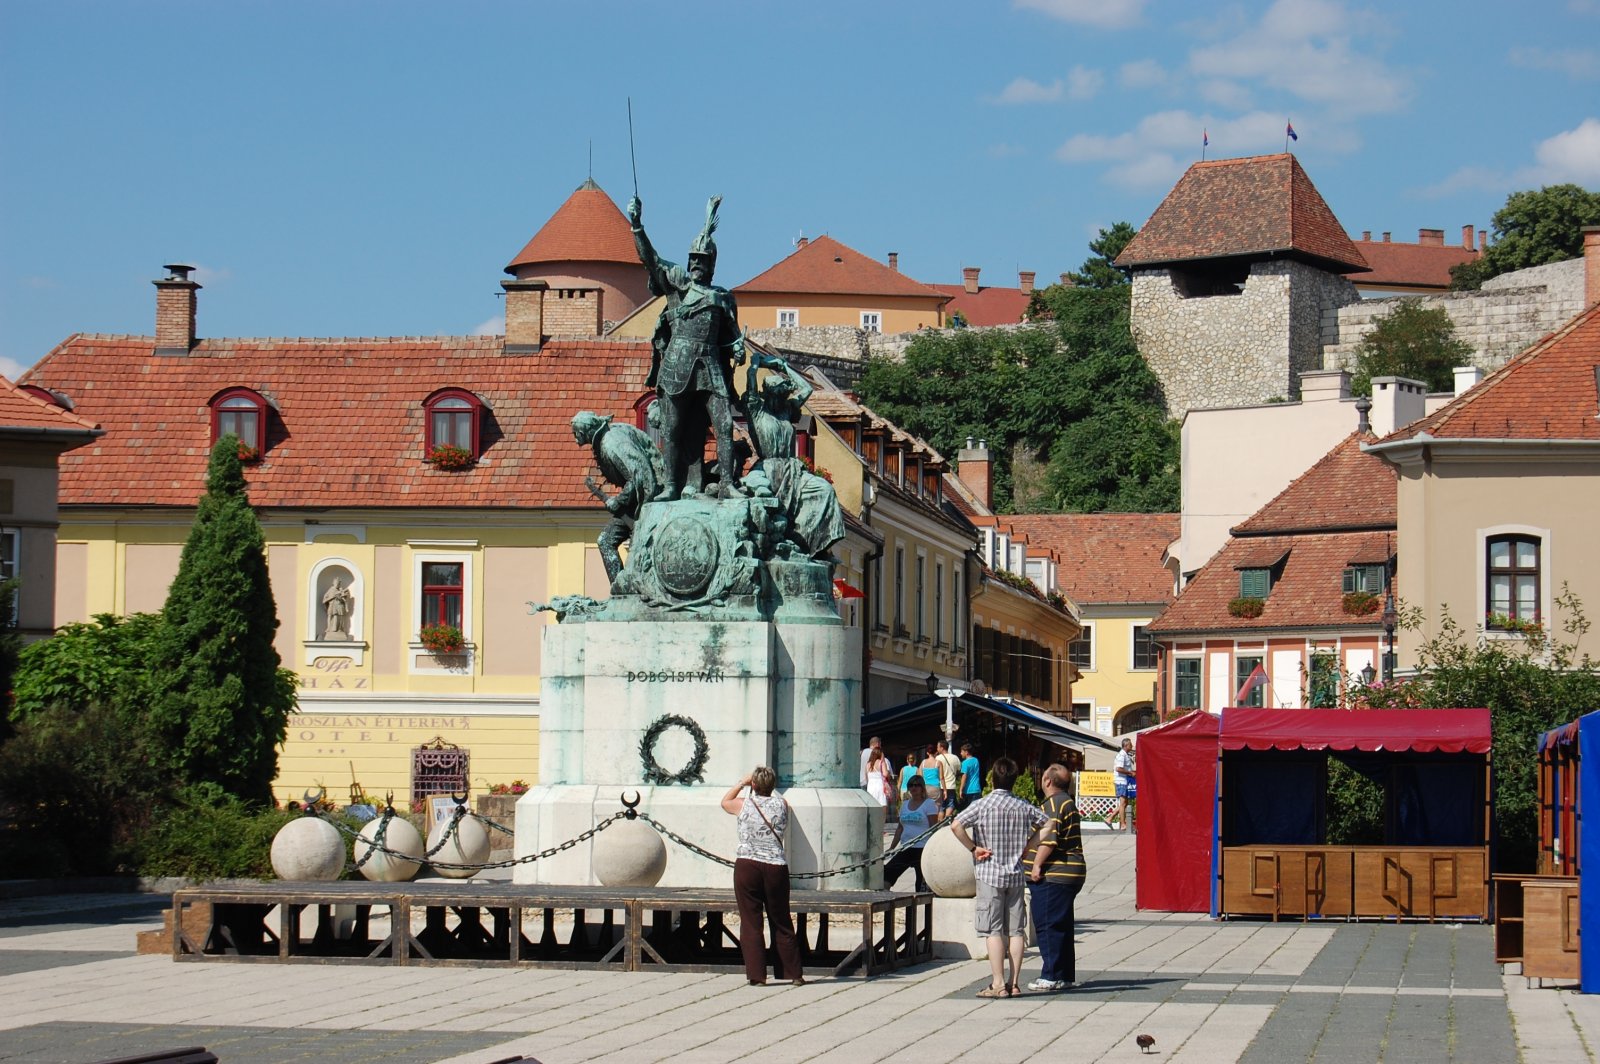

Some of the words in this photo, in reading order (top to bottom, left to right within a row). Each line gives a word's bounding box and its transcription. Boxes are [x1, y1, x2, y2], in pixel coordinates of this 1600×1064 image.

[315, 659, 351, 672] Offi
[301, 675, 367, 689] HÁZ
[375, 714, 455, 728] ÉTTEREM
[300, 731, 399, 742] OTEL
